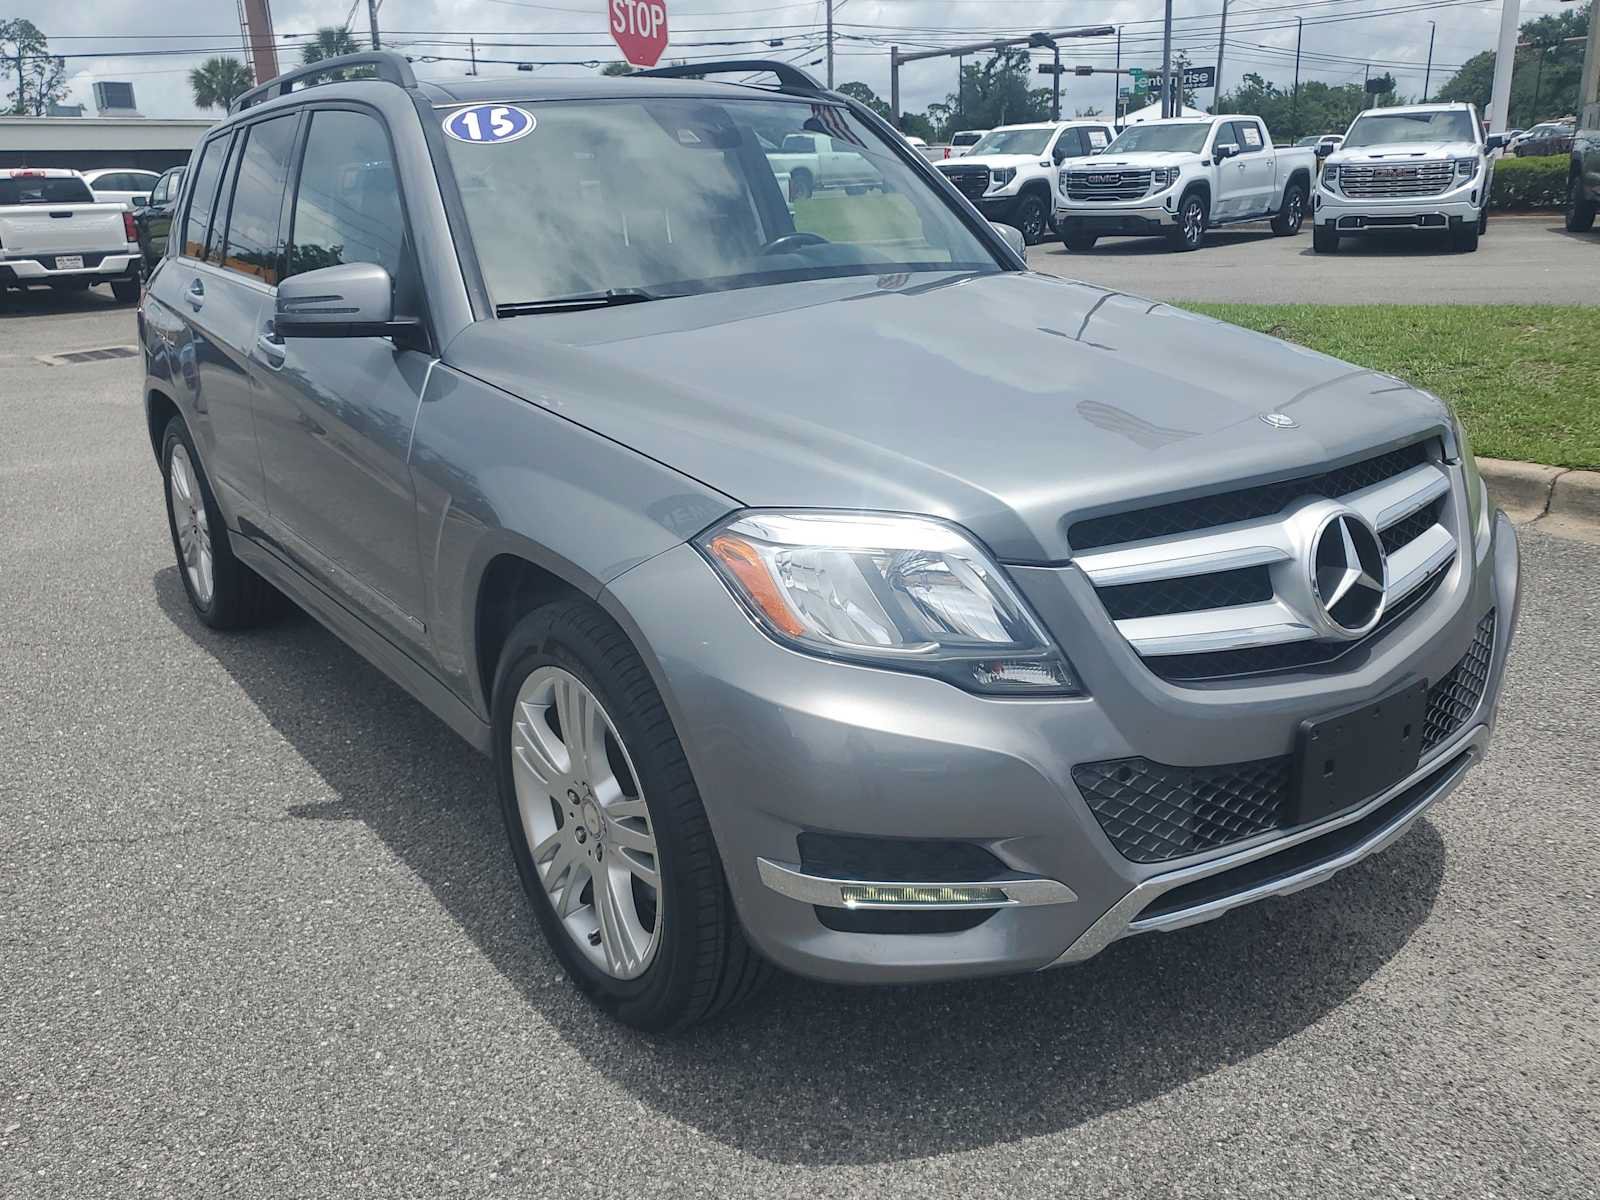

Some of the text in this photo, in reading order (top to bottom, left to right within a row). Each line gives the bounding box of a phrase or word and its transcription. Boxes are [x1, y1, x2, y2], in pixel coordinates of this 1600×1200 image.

[612, 0, 664, 38] STOP
[462, 108, 514, 140] 15
[1087, 174, 1119, 184] GMC
